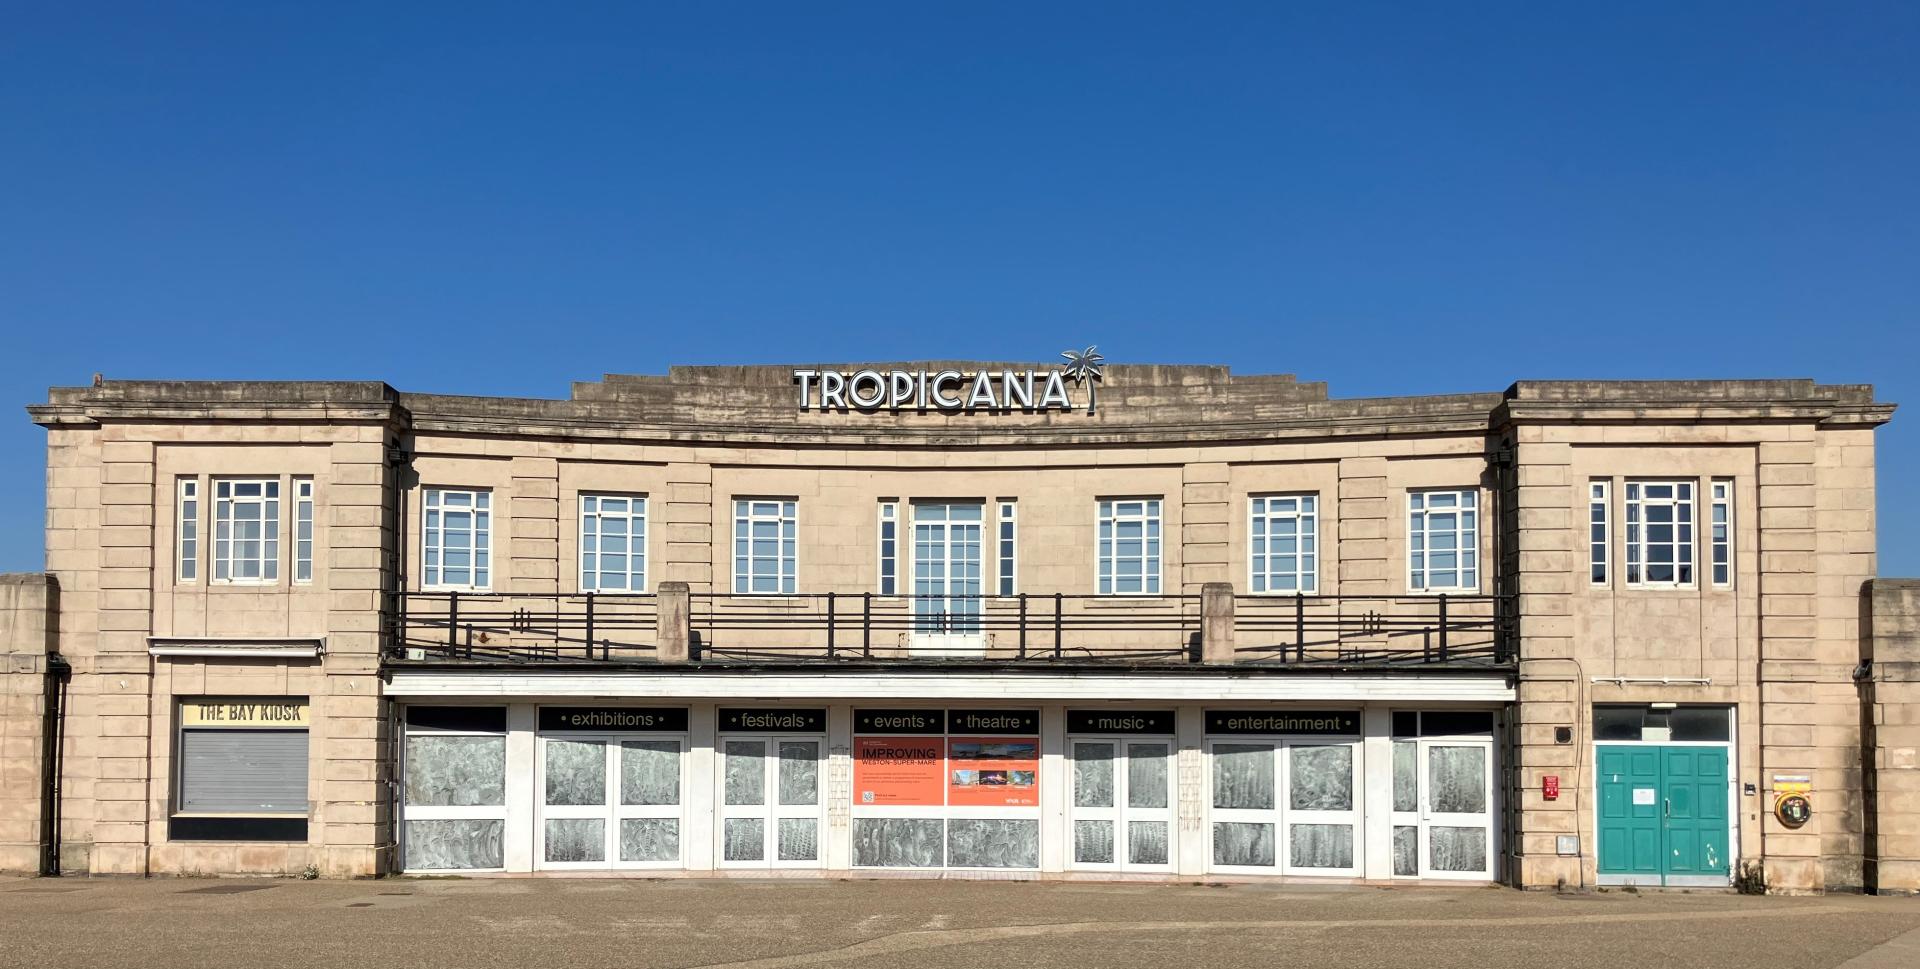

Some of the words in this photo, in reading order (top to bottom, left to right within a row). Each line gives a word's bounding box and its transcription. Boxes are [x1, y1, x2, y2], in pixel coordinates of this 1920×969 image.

[793, 369, 1071, 409] TROPICANA
[198, 704, 224, 720] THE
[229, 704, 256, 720] BAY
[260, 704, 301, 720] KIOSK
[571, 712, 654, 726] exhibitions
[741, 713, 805, 727] festivals
[874, 715, 925, 728] events
[967, 715, 1020, 729] theatre
[1098, 715, 1145, 729] music
[1227, 716, 1340, 730] entertainment
[862, 748, 936, 759] IMPROVING
